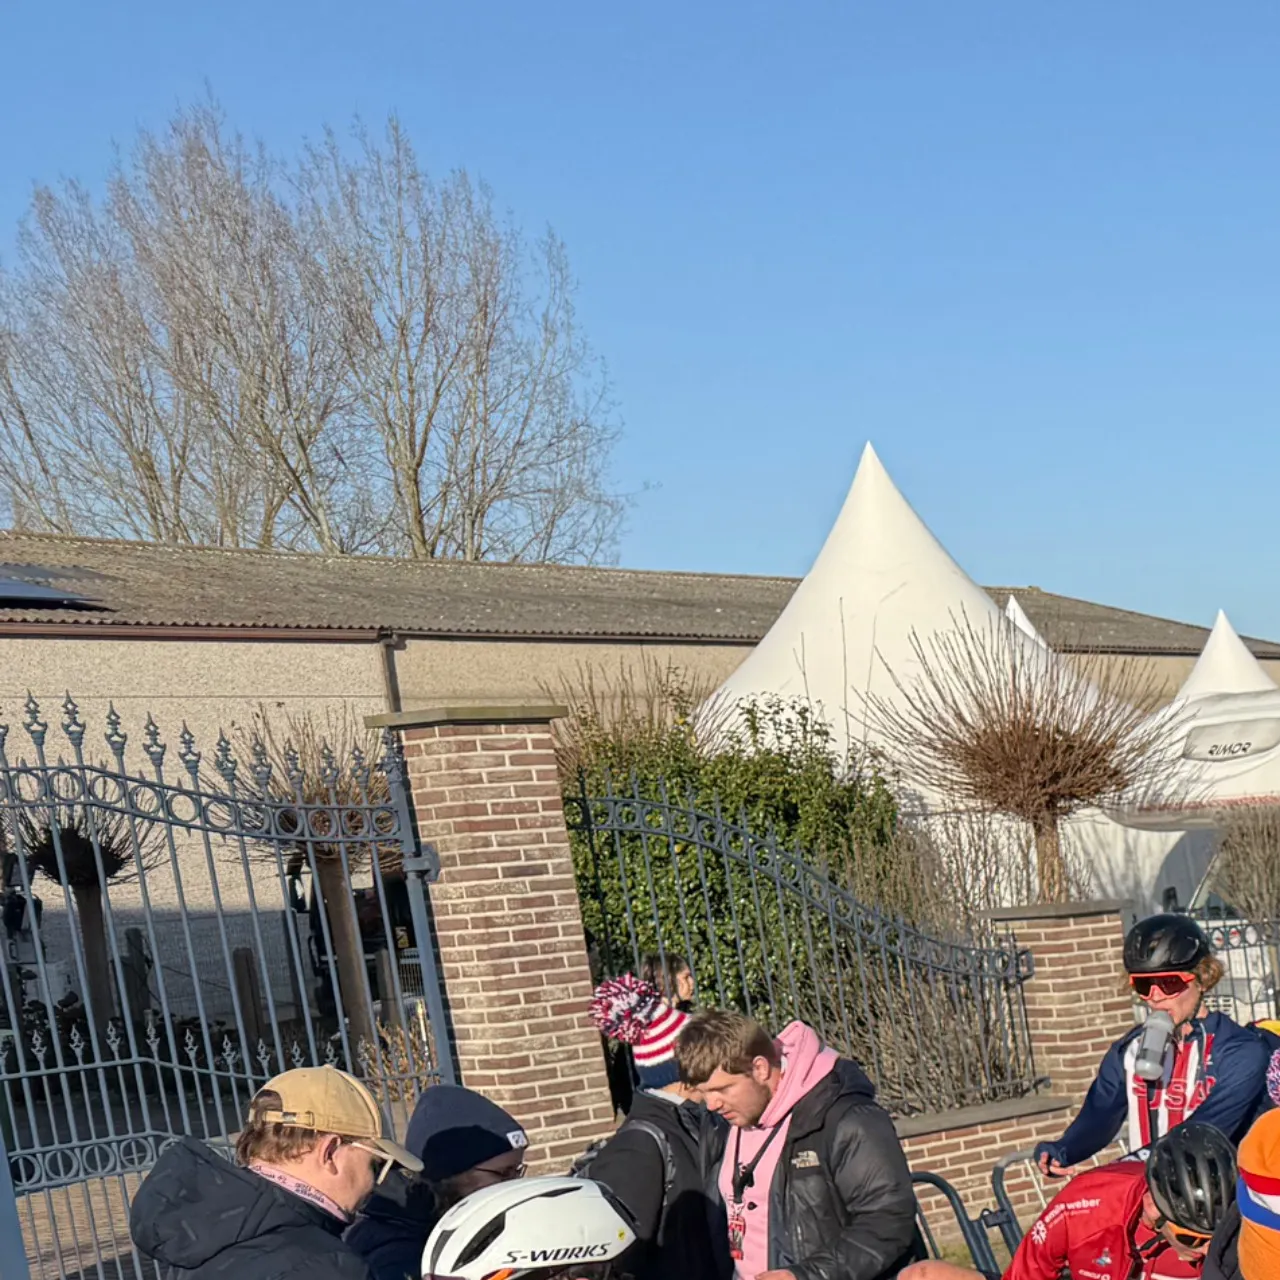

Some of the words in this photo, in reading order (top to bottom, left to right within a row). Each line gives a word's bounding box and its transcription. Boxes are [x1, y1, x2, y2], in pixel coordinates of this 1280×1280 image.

[1208, 742, 1252, 756] RIMOR
[1066, 1199, 1101, 1211] weber
[501, 1241, 612, 1265] S-WORKS
